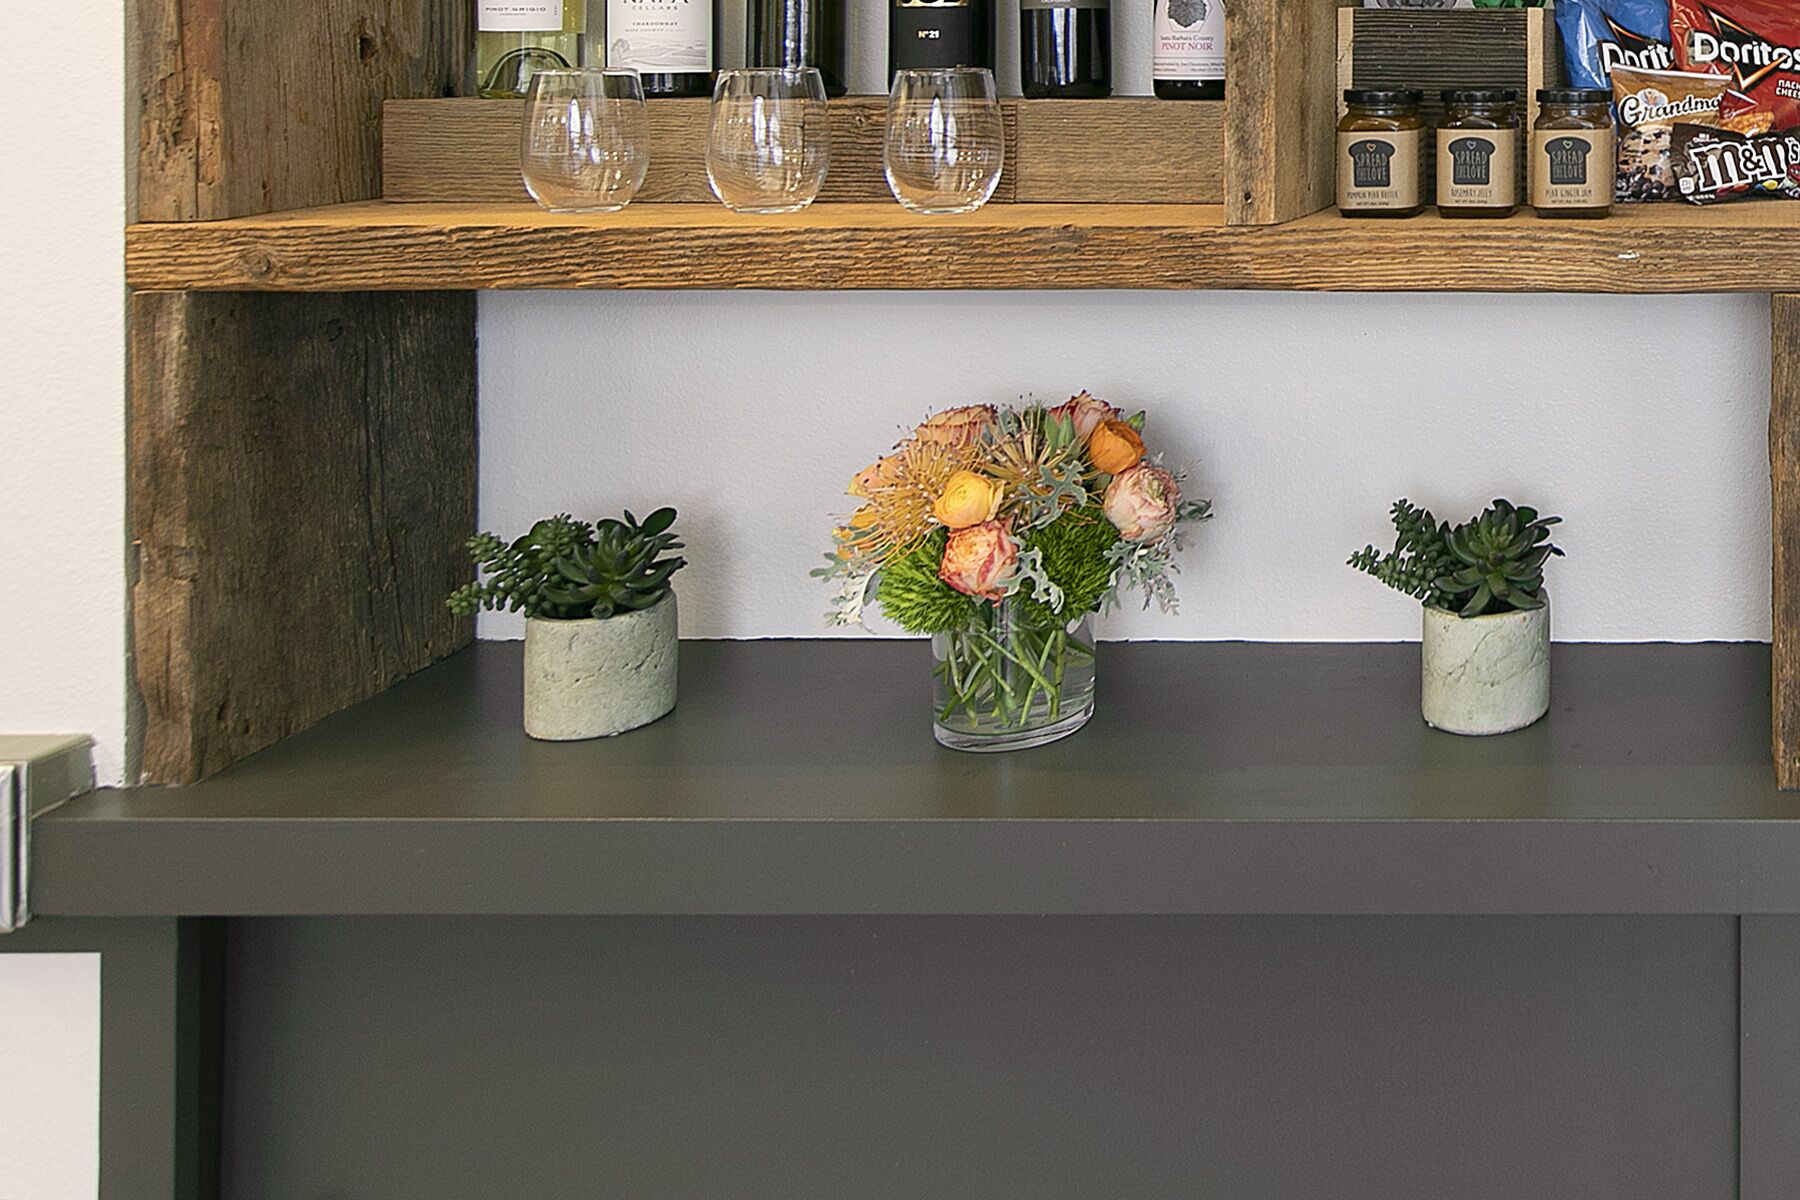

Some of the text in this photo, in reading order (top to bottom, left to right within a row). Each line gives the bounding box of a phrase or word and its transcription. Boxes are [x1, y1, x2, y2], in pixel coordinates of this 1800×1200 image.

[1161, 43, 1213, 51] PINOT NOIR
[1355, 153, 1387, 167] SPREAD
[1455, 150, 1487, 165] SPREAD
[1551, 150, 1584, 164] SPREAD
[1367, 167, 1387, 181] LOVE
[1466, 165, 1486, 179] LOVE
[1563, 164, 1583, 179] LOVE
